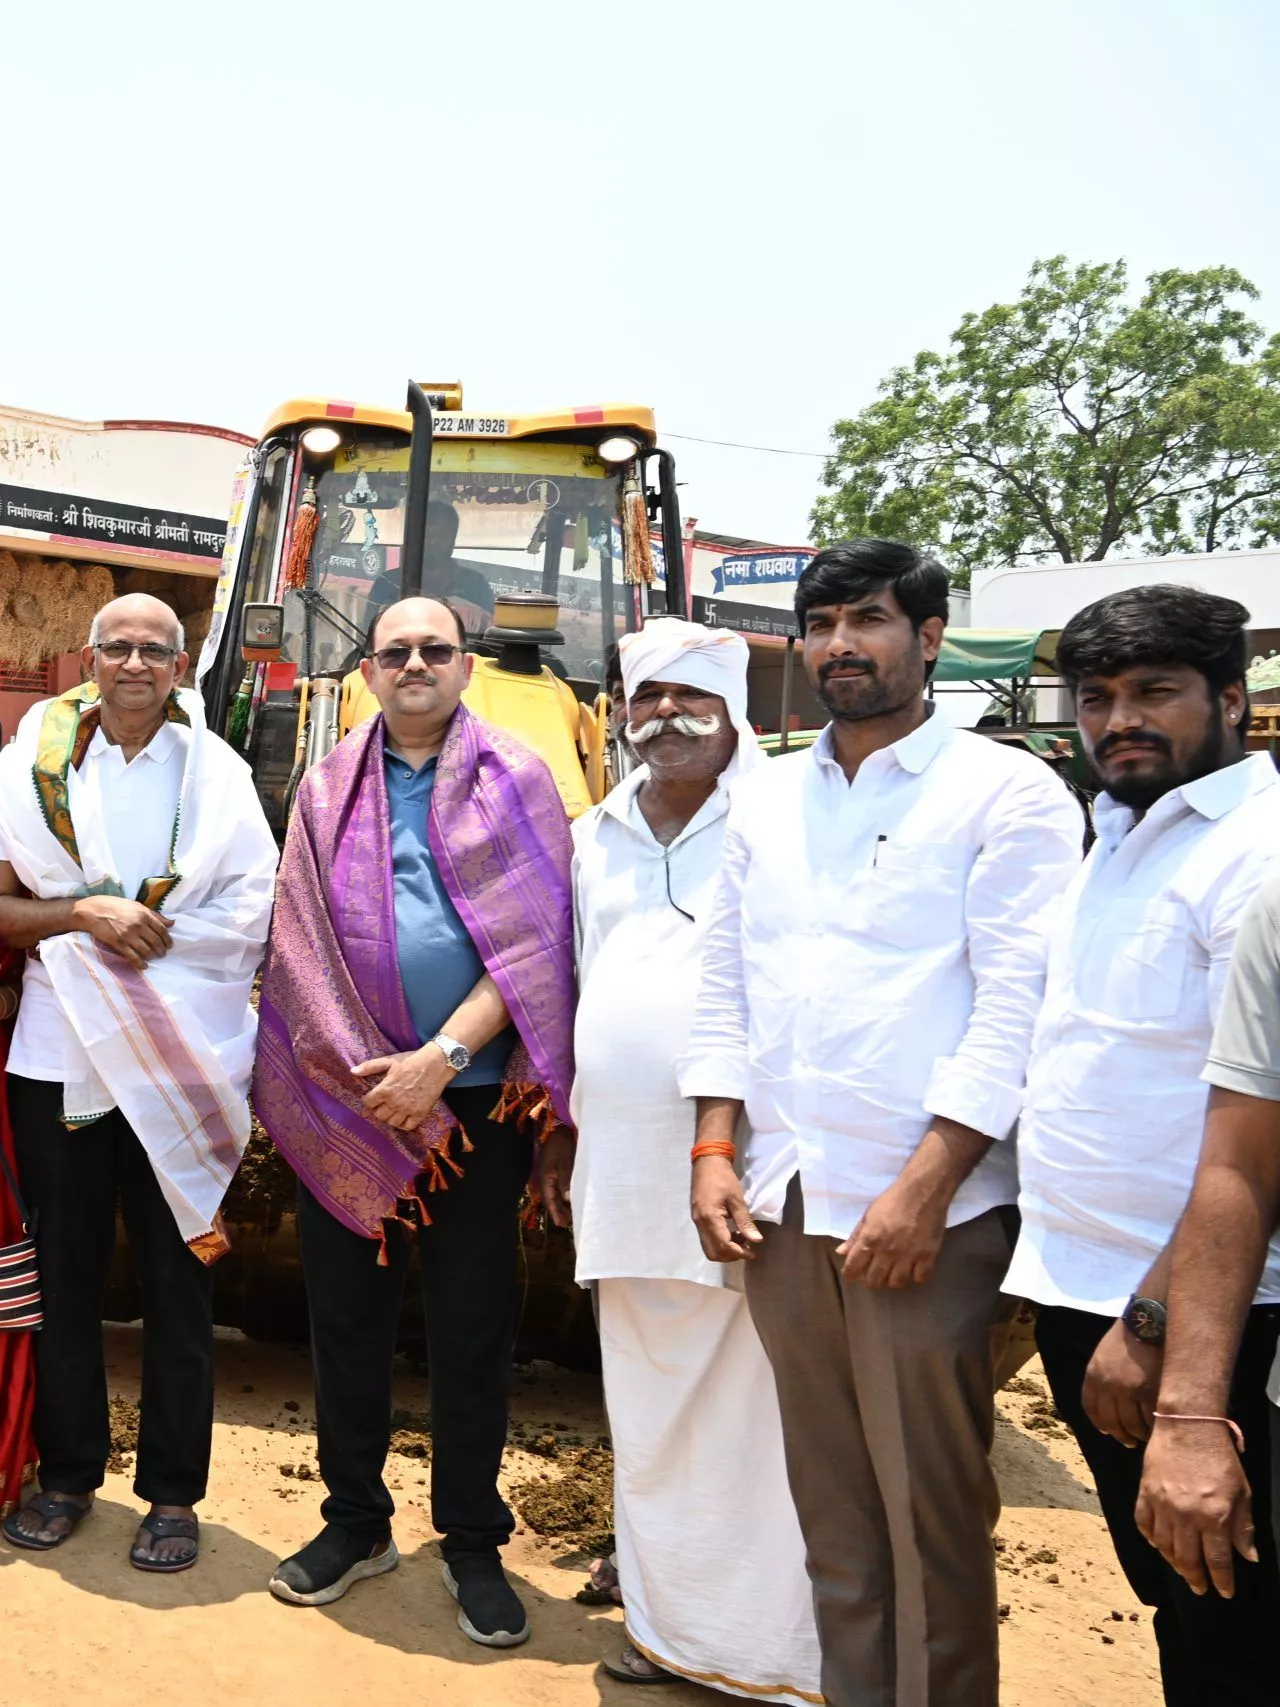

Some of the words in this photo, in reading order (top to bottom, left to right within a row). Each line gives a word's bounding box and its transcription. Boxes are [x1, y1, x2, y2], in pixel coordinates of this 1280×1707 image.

[457, 417, 475, 432] AM
[478, 418, 506, 434] 3926
[61, 503, 78, 527] श्री
[82, 506, 151, 538] शिवकुमारजी
[154, 520, 189, 543] श्रीमती
